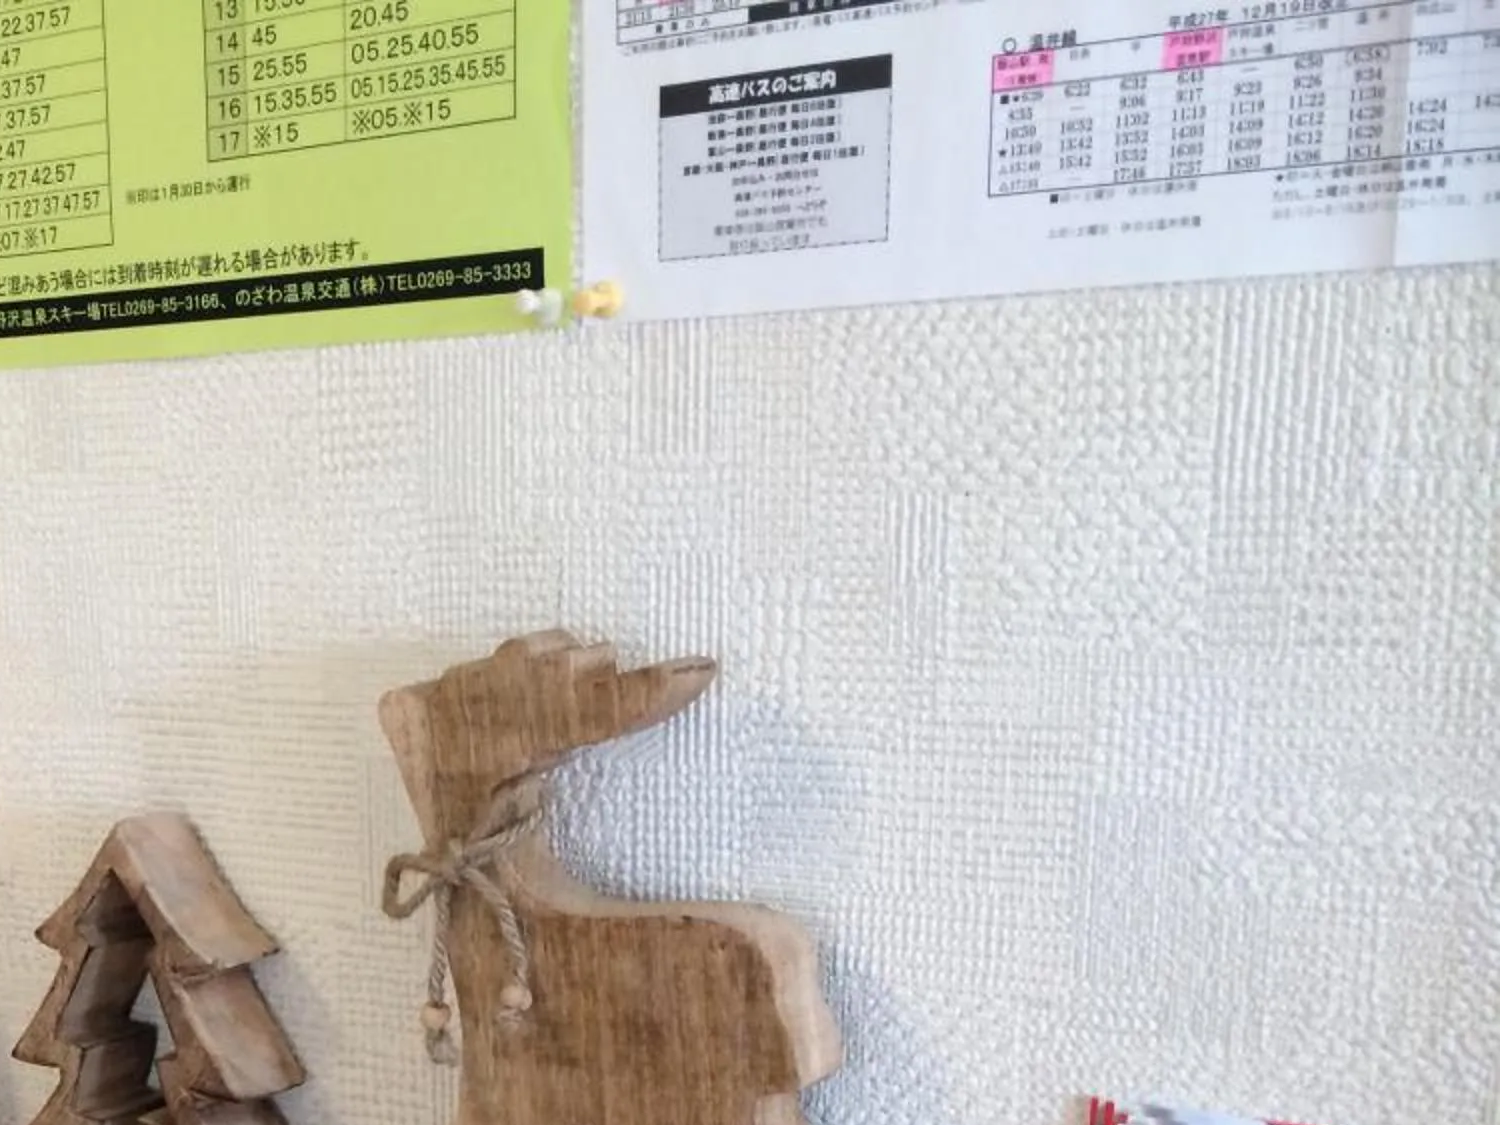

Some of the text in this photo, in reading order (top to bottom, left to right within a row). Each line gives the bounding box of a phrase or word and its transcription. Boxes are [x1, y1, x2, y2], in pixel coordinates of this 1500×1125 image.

[216, 0, 238, 20] 13
[216, 32, 239, 51] 14
[252, 24, 277, 45] 45
[218, 64, 240, 85] 15
[708, 69, 837, 105] 高速バスのご案内
[219, 98, 241, 119] 16
[219, 132, 240, 152] 17
